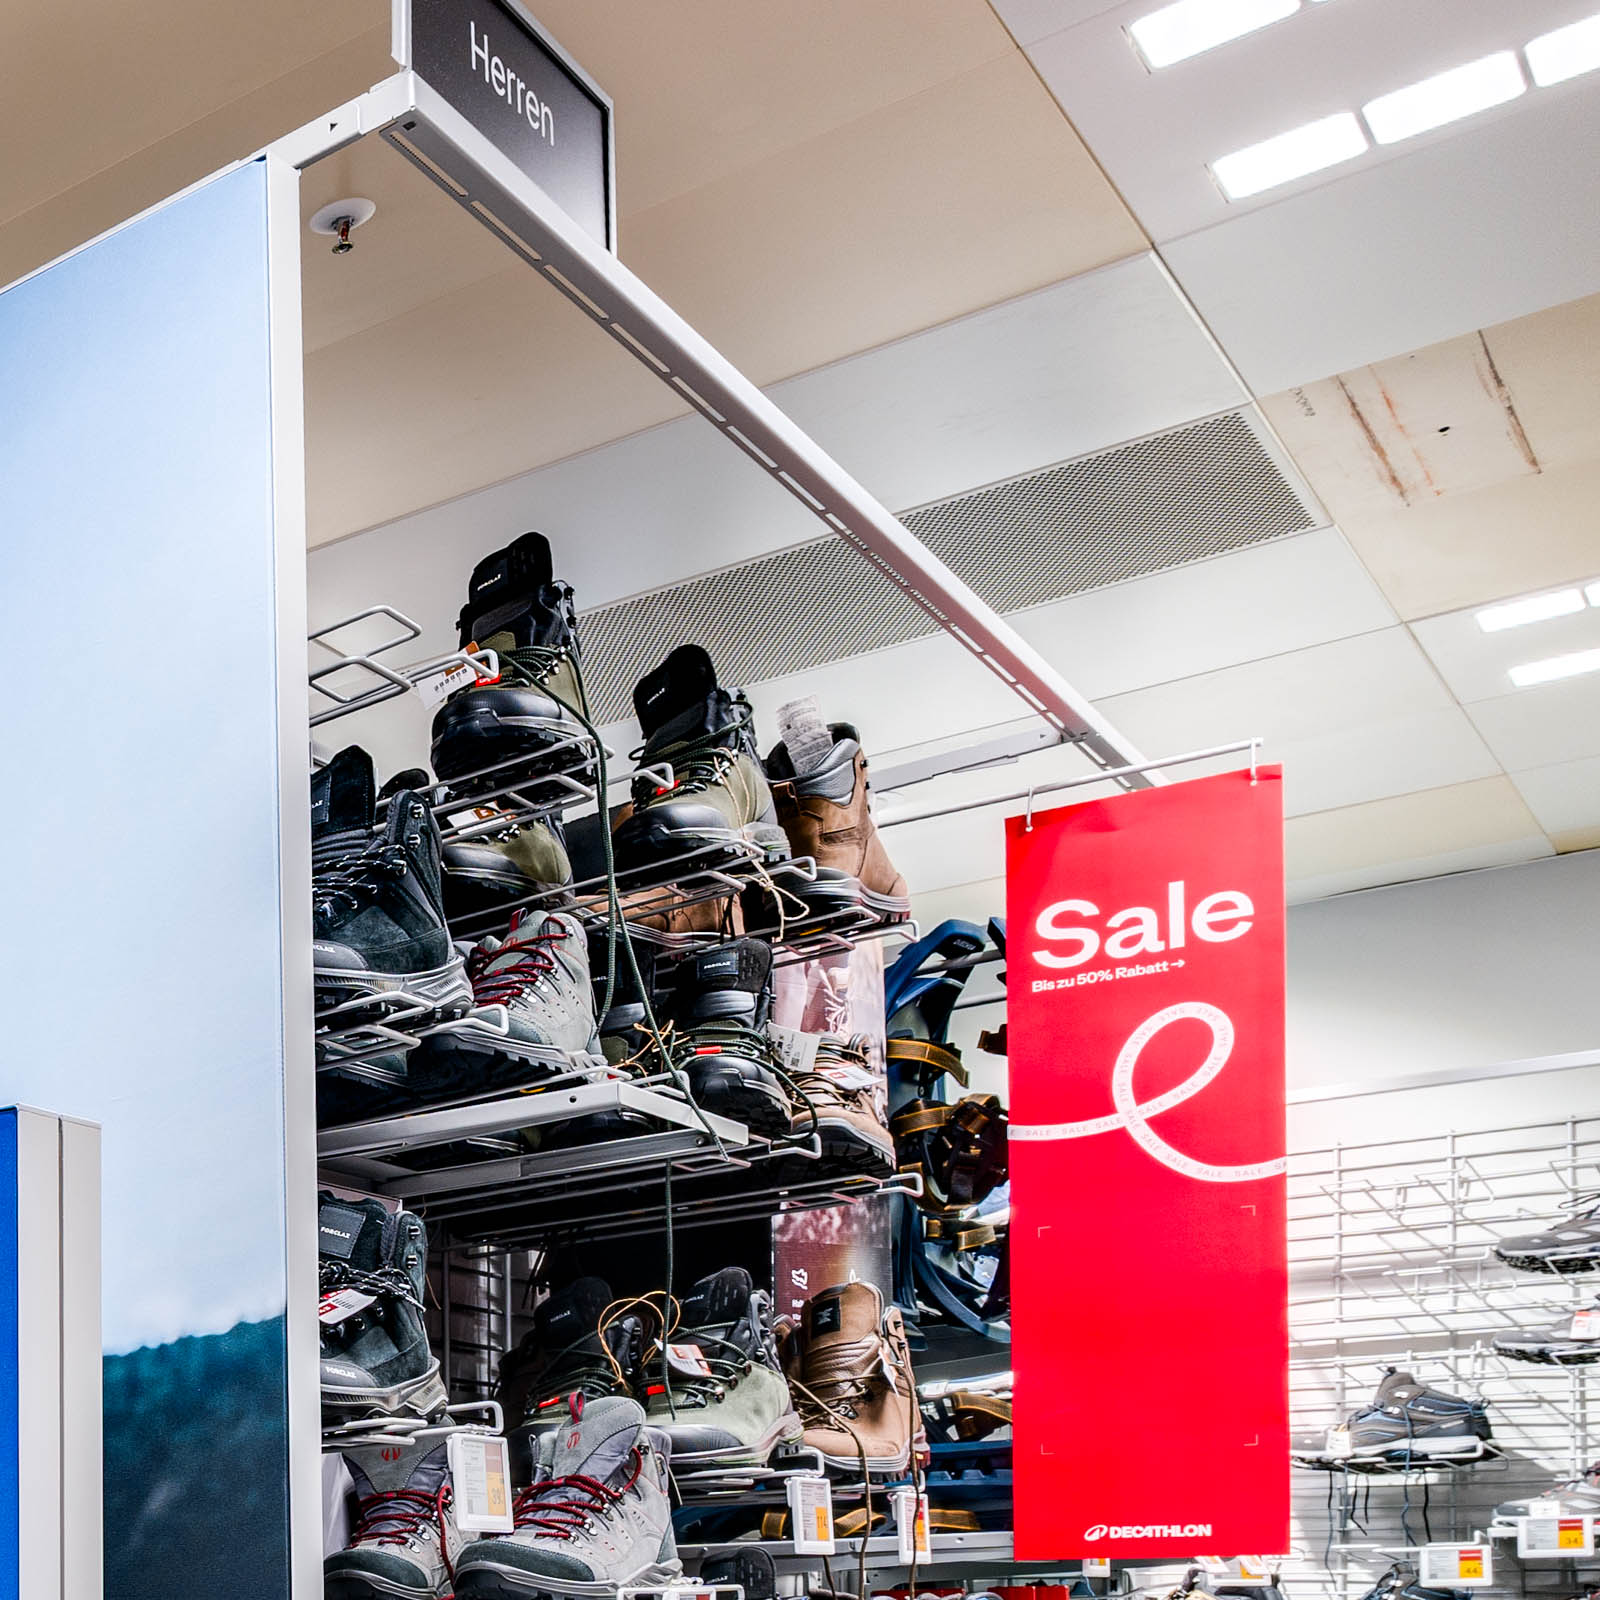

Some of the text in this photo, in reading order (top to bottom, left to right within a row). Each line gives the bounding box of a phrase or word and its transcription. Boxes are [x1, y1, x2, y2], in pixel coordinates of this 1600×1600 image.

[470, 20, 554, 146] Herren
[1032, 881, 1254, 968] Sale
[313, 944, 336, 953] CLAZ
[1032, 961, 1168, 993] Bis zu 50% Rabatt
[320, 1226, 351, 1239] FORCLAZ
[324, 1366, 357, 1378] FORCLAZ
[1109, 1523, 1212, 1540] DECATHLON
